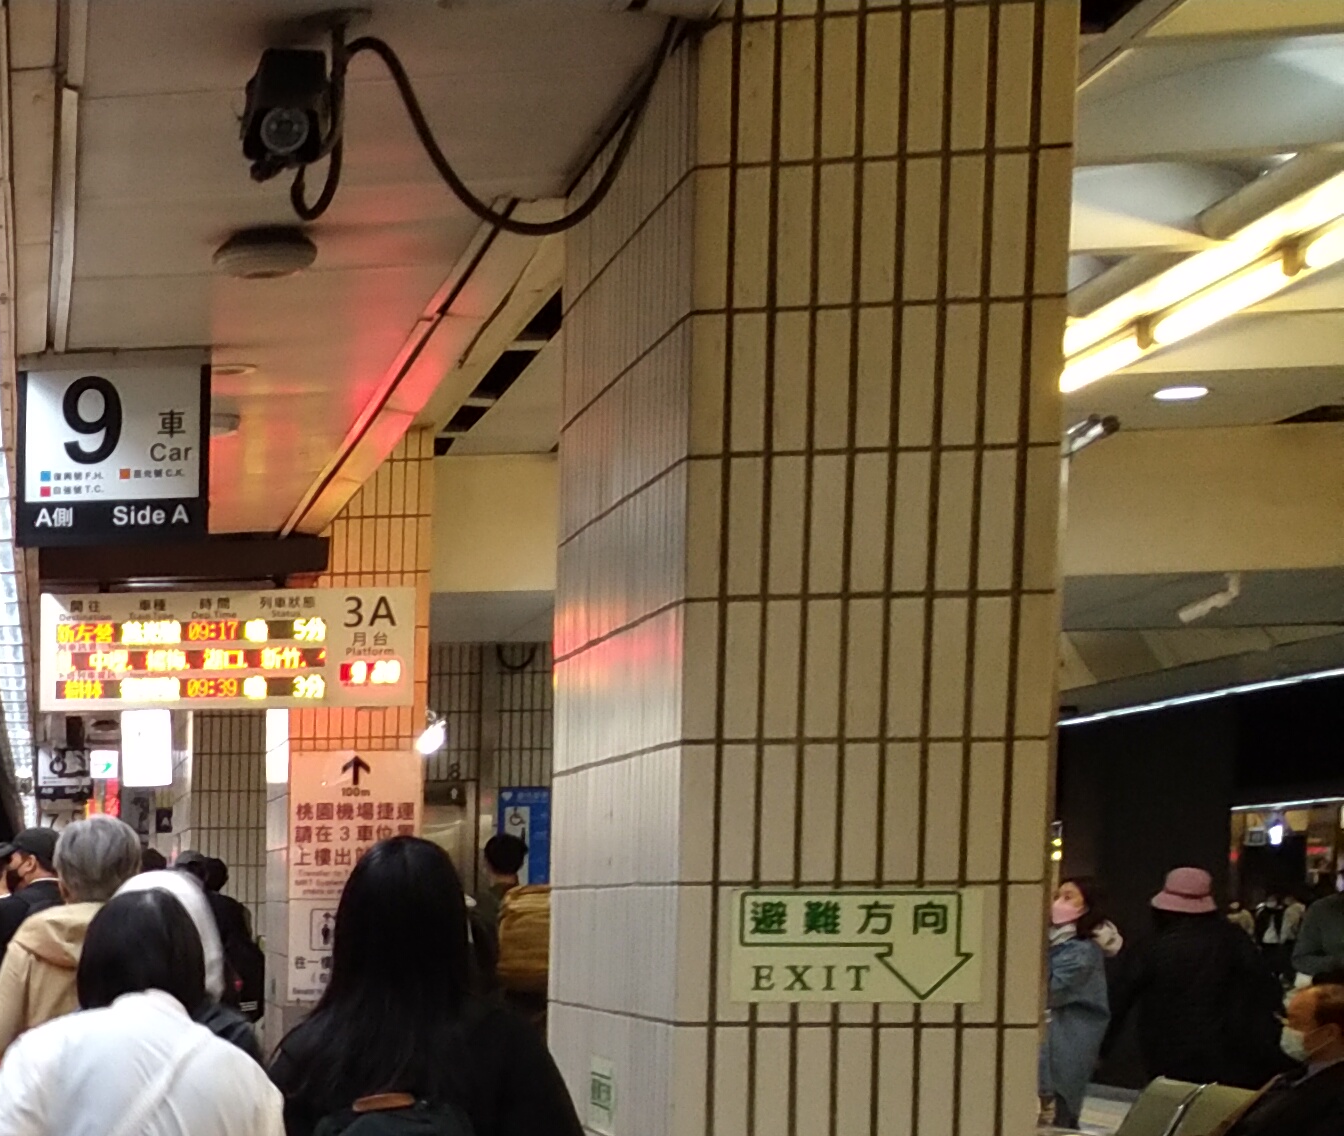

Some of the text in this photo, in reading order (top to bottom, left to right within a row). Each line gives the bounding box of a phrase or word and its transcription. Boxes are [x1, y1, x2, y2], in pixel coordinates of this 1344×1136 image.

[63, 375, 123, 465] 9
[156, 409, 187, 439] 車
[149, 442, 193, 462] Car
[35, 507, 74, 528] A側
[112, 503, 190, 526] Side A
[343, 595, 397, 628] 3A
[188, 620, 239, 641] 09:17
[352, 631, 389, 647] 月台
[345, 646, 395, 657] Platform
[187, 678, 238, 698] 09:39
[295, 802, 415, 821] 桃園機場捷運
[749, 900, 949, 936] 避難方向
[751, 964, 870, 992] EXIT
